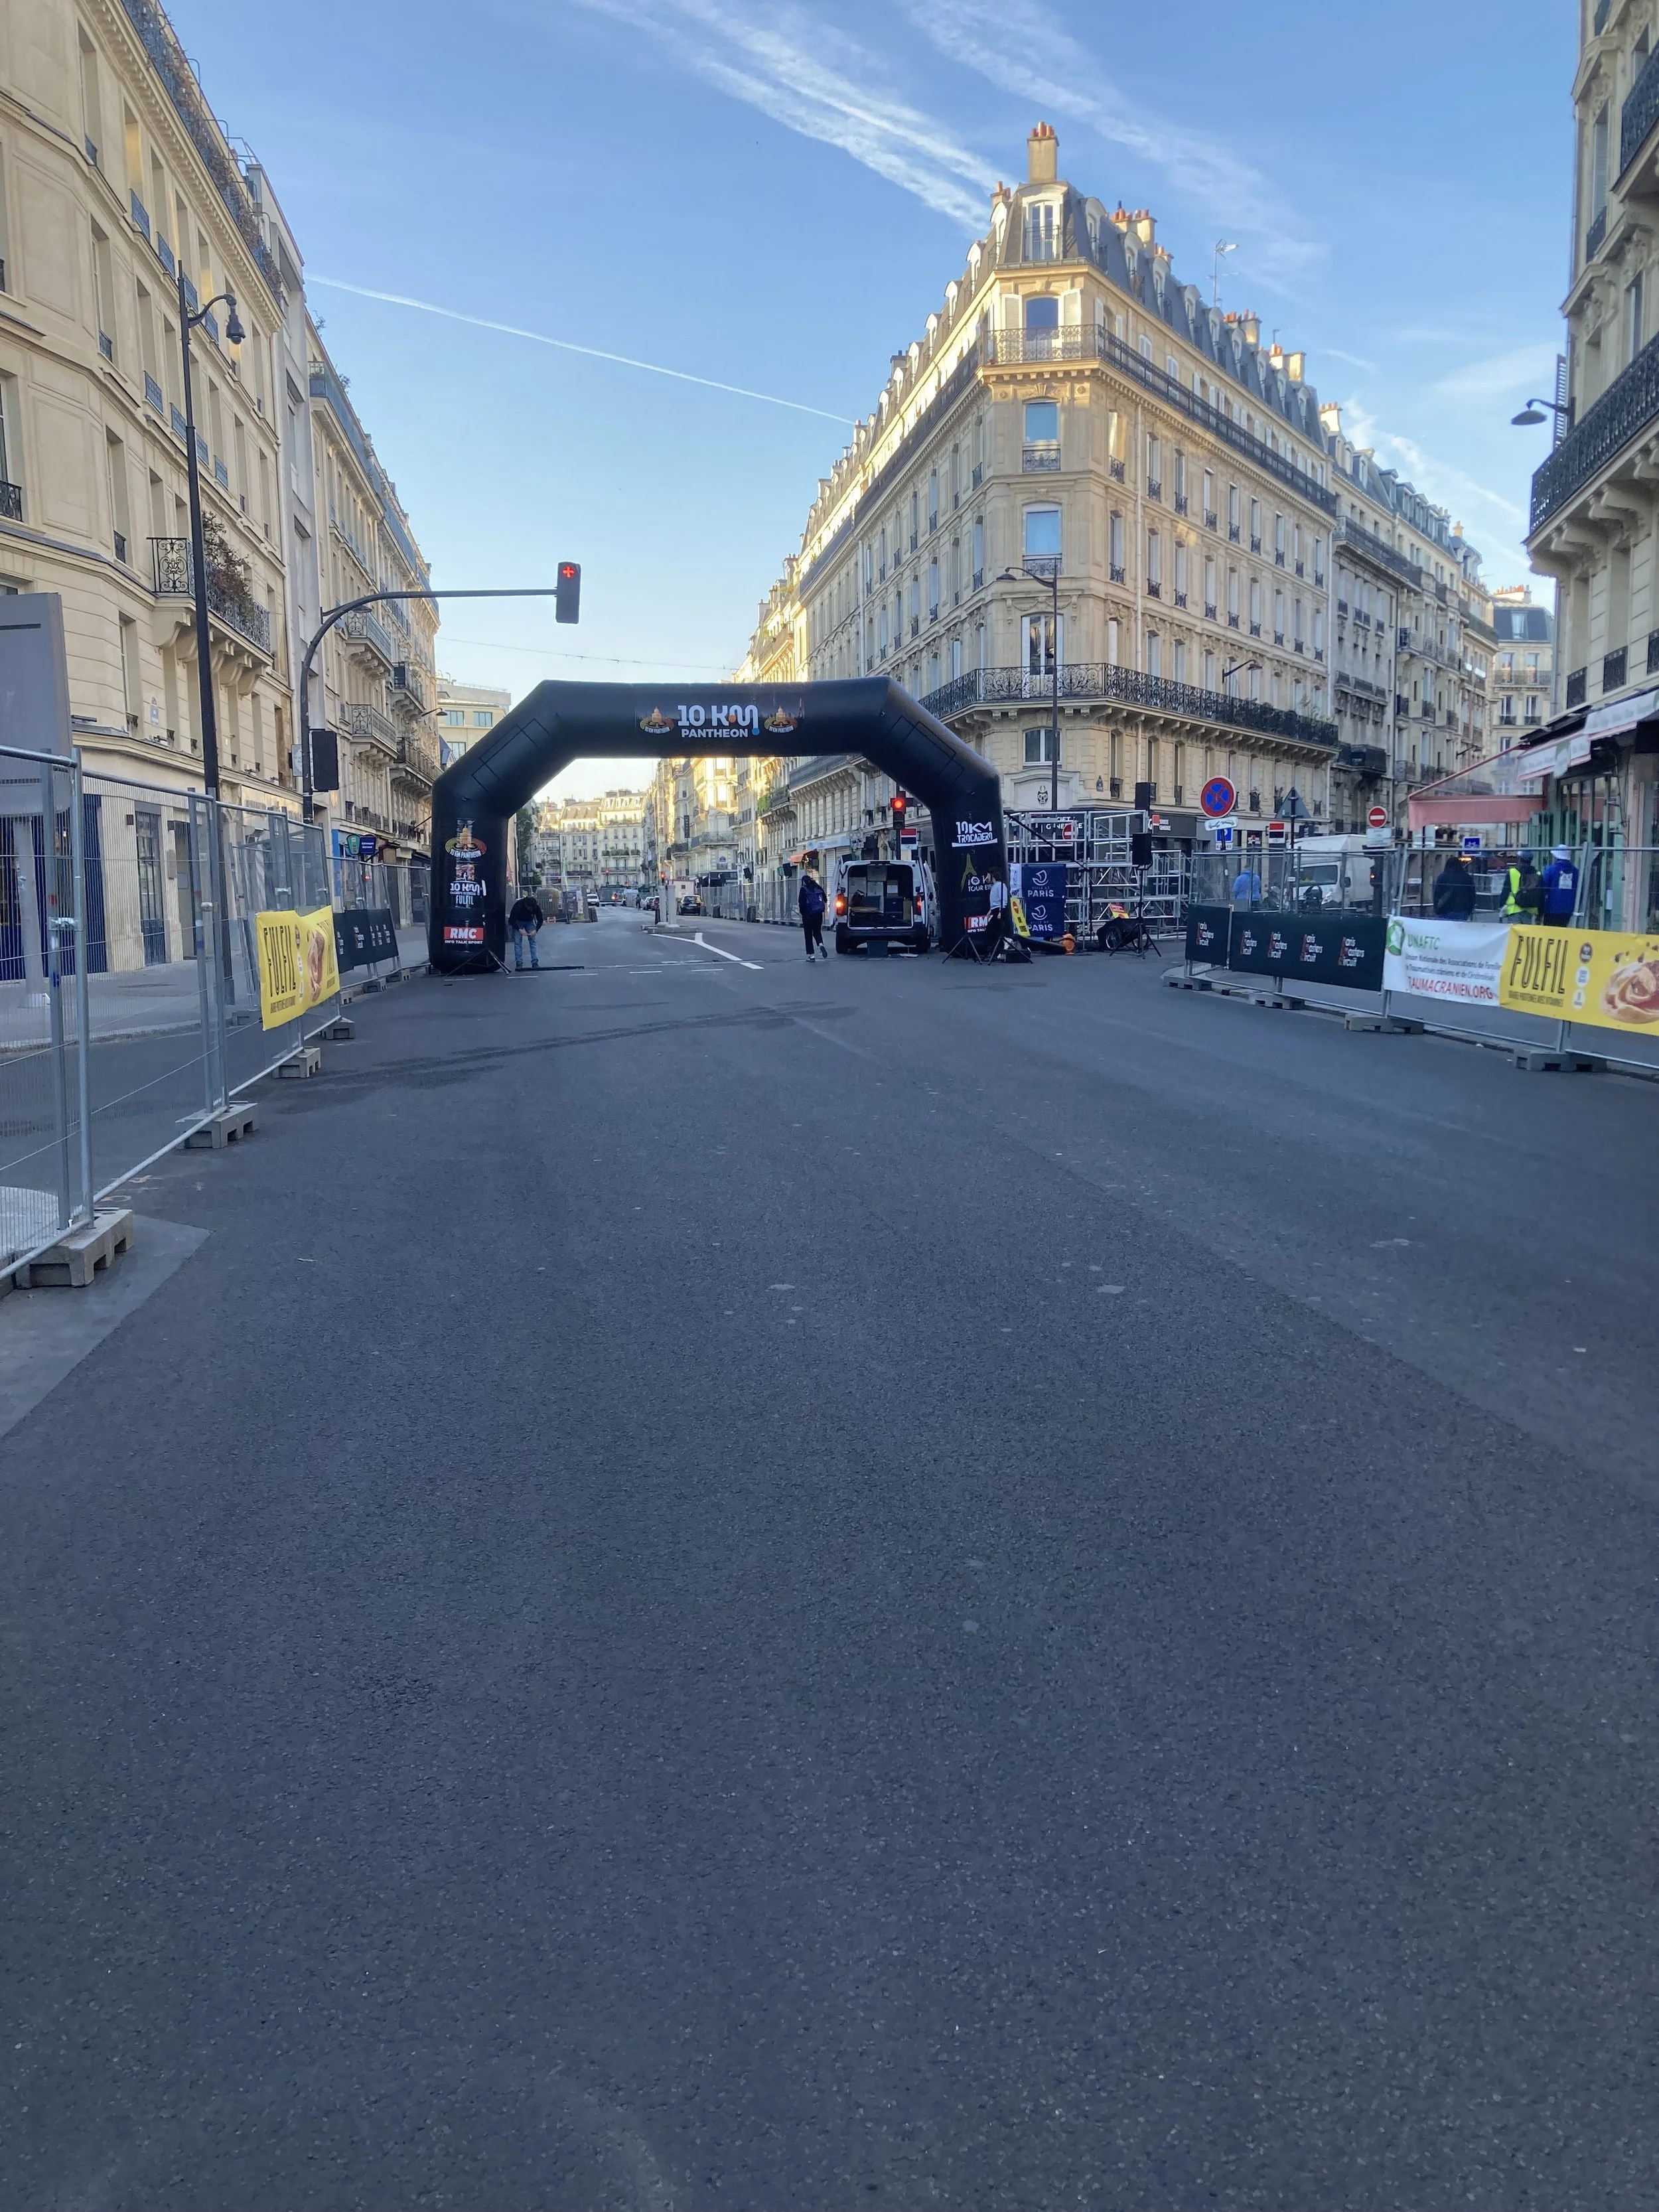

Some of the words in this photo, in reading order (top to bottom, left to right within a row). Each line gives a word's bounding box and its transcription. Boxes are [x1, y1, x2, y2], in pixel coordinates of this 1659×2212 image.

[678, 705, 705, 727] 10
[681, 729, 749, 738] PANTHEON
[957, 832, 993, 843] TROCADERO
[450, 883, 461, 891] 10
[455, 895, 474, 905] FULFIL
[971, 916, 988, 928] RM
[450, 928, 477, 939] RMC
[1407, 933, 1441, 950] UNAFTC
[263, 925, 297, 997] FULFIL
[1510, 934, 1569, 995] FULFIL
